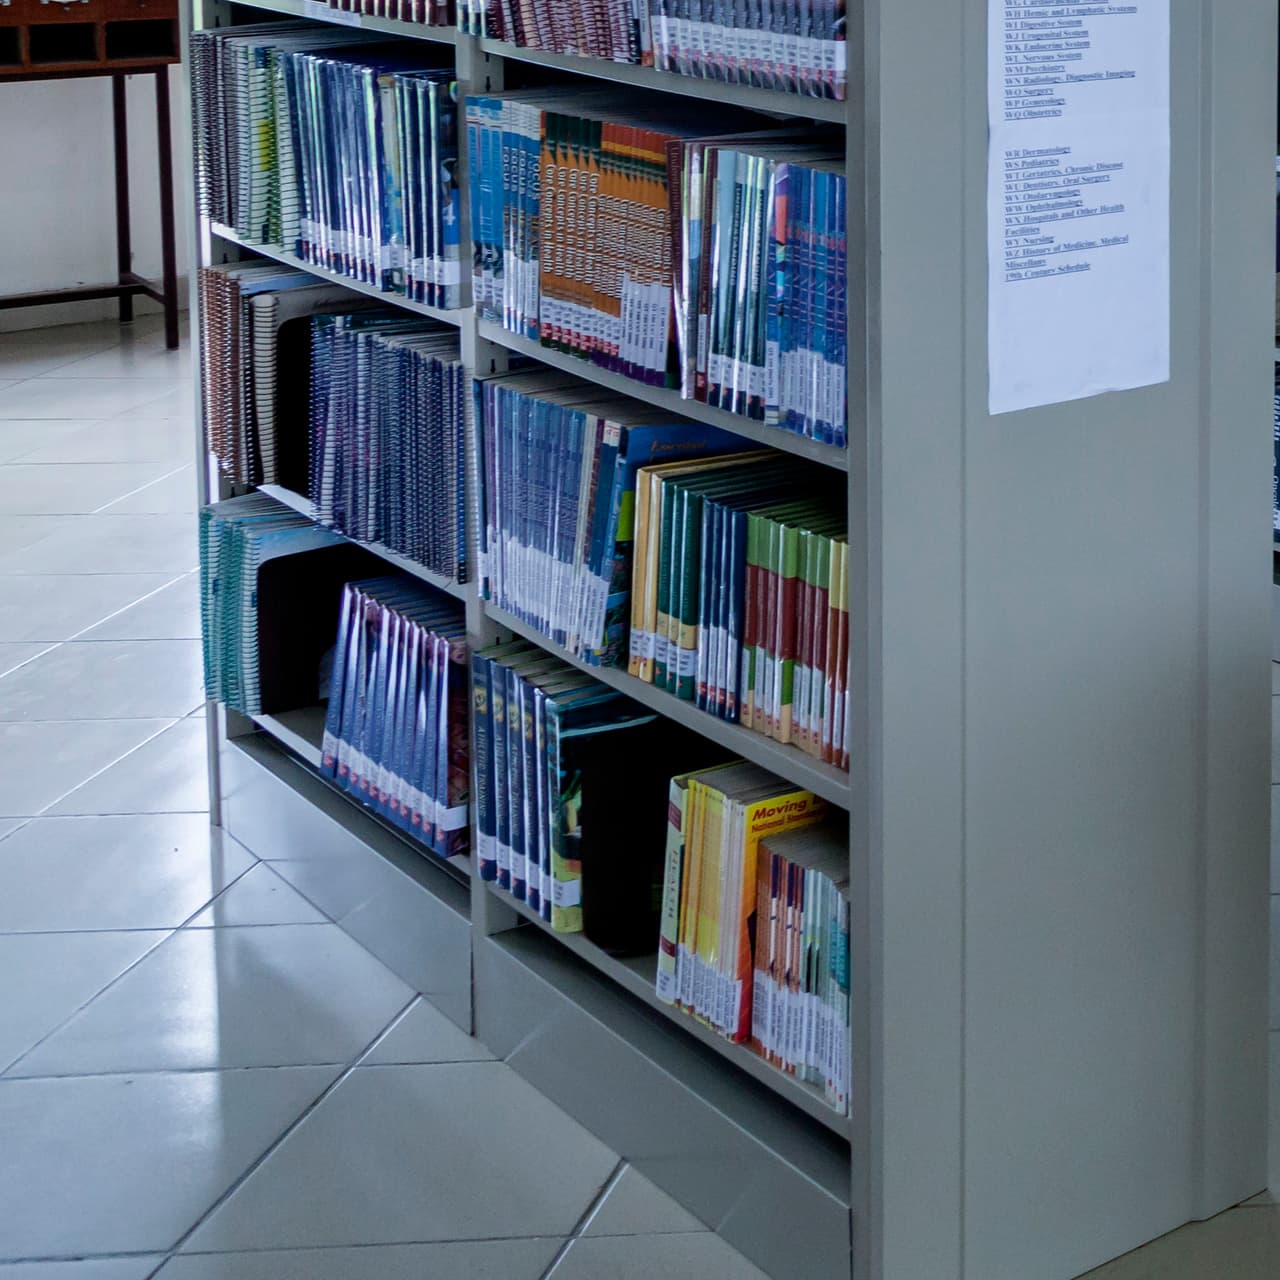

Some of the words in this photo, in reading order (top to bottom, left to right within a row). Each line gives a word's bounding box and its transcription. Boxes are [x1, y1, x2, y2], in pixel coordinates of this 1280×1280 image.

[544, 163, 556, 184] Core
[568, 168, 579, 189] Core
[579, 170, 590, 192] Core
[589, 172, 601, 194] Core
[543, 186, 556, 227] Concepts
[567, 191, 578, 233] Concepts
[577, 193, 589, 235] Concepts
[587, 195, 599, 237] Concepts
[543, 231, 552, 239] in
[566, 235, 575, 245] in
[576, 238, 584, 247] in
[585, 240, 595, 250] in
[543, 241, 555, 273] Health
[565, 246, 576, 278] Health
[575, 249, 586, 281] Health
[584, 252, 596, 283] Health
[752, 798, 806, 821] Moving
